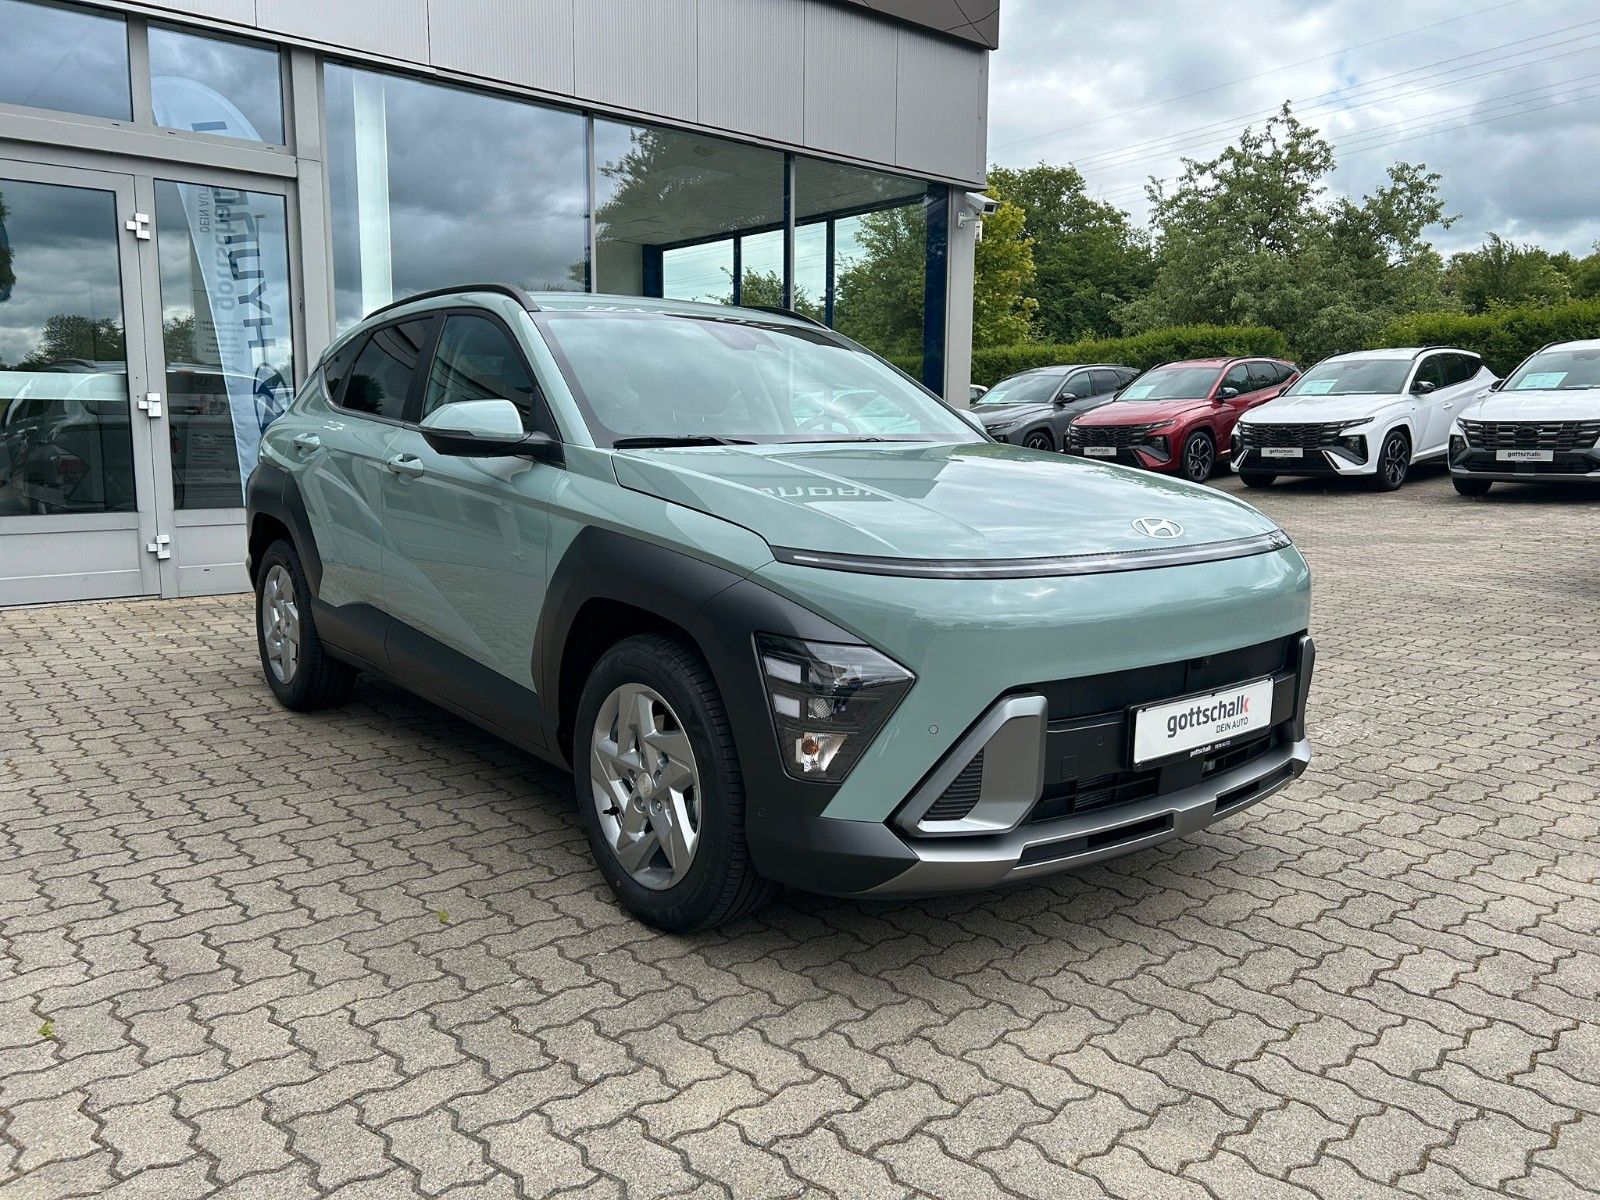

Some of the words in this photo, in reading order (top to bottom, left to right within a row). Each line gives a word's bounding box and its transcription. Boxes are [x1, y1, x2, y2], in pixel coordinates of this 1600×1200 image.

[1167, 694, 1250, 738] gottschalk
[1216, 722, 1231, 734] DEIN
[1231, 716, 1249, 730] AUTO
